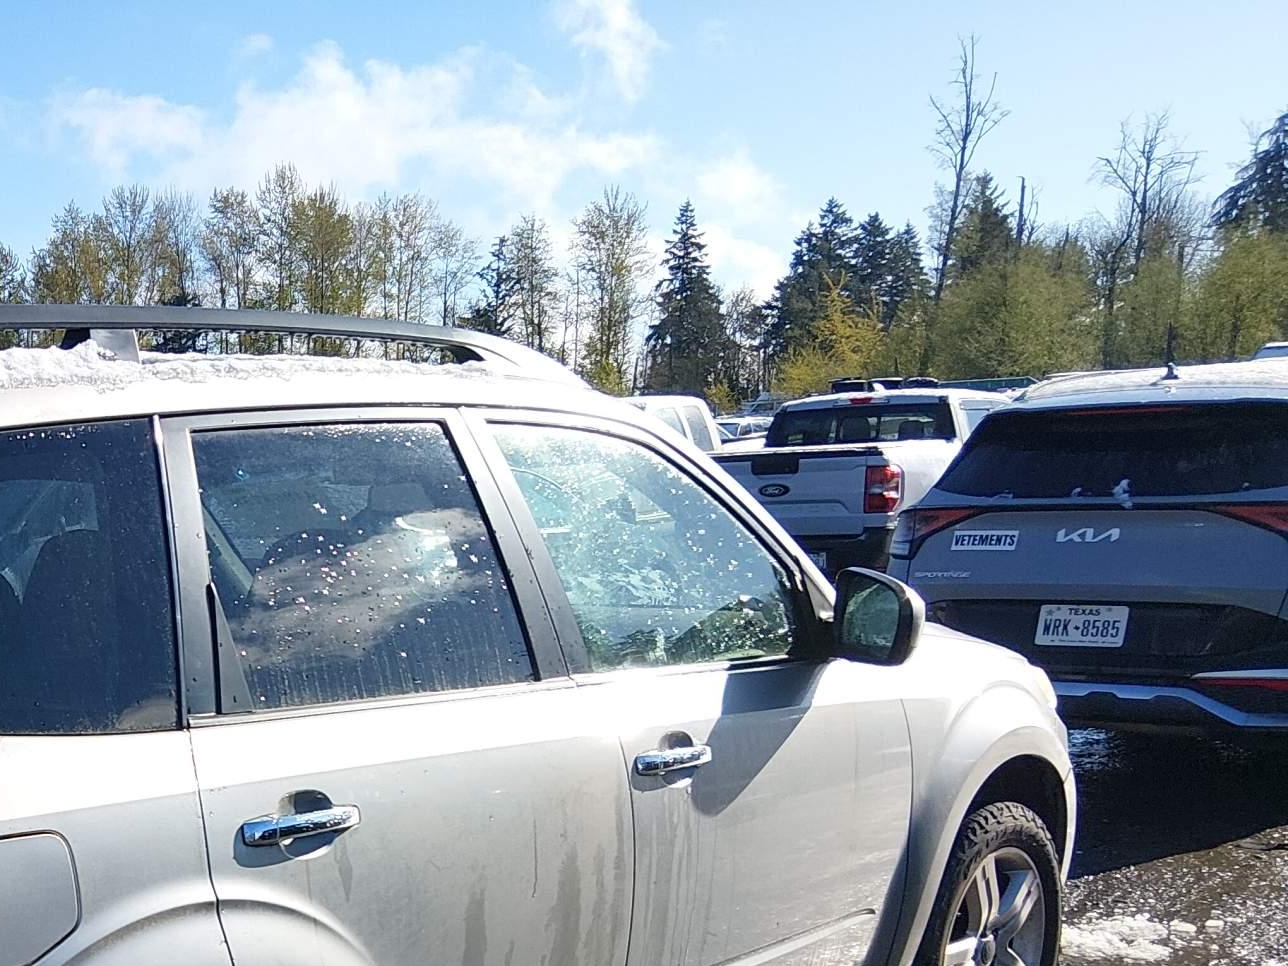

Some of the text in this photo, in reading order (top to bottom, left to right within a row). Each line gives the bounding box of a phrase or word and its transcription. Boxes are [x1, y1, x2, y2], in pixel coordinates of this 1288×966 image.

[954, 534, 1017, 547] VETEMENTS
[1056, 527, 1121, 543] KIA
[1068, 607, 1101, 617] TEXAS
[1042, 618, 1121, 638] WRK 8585
